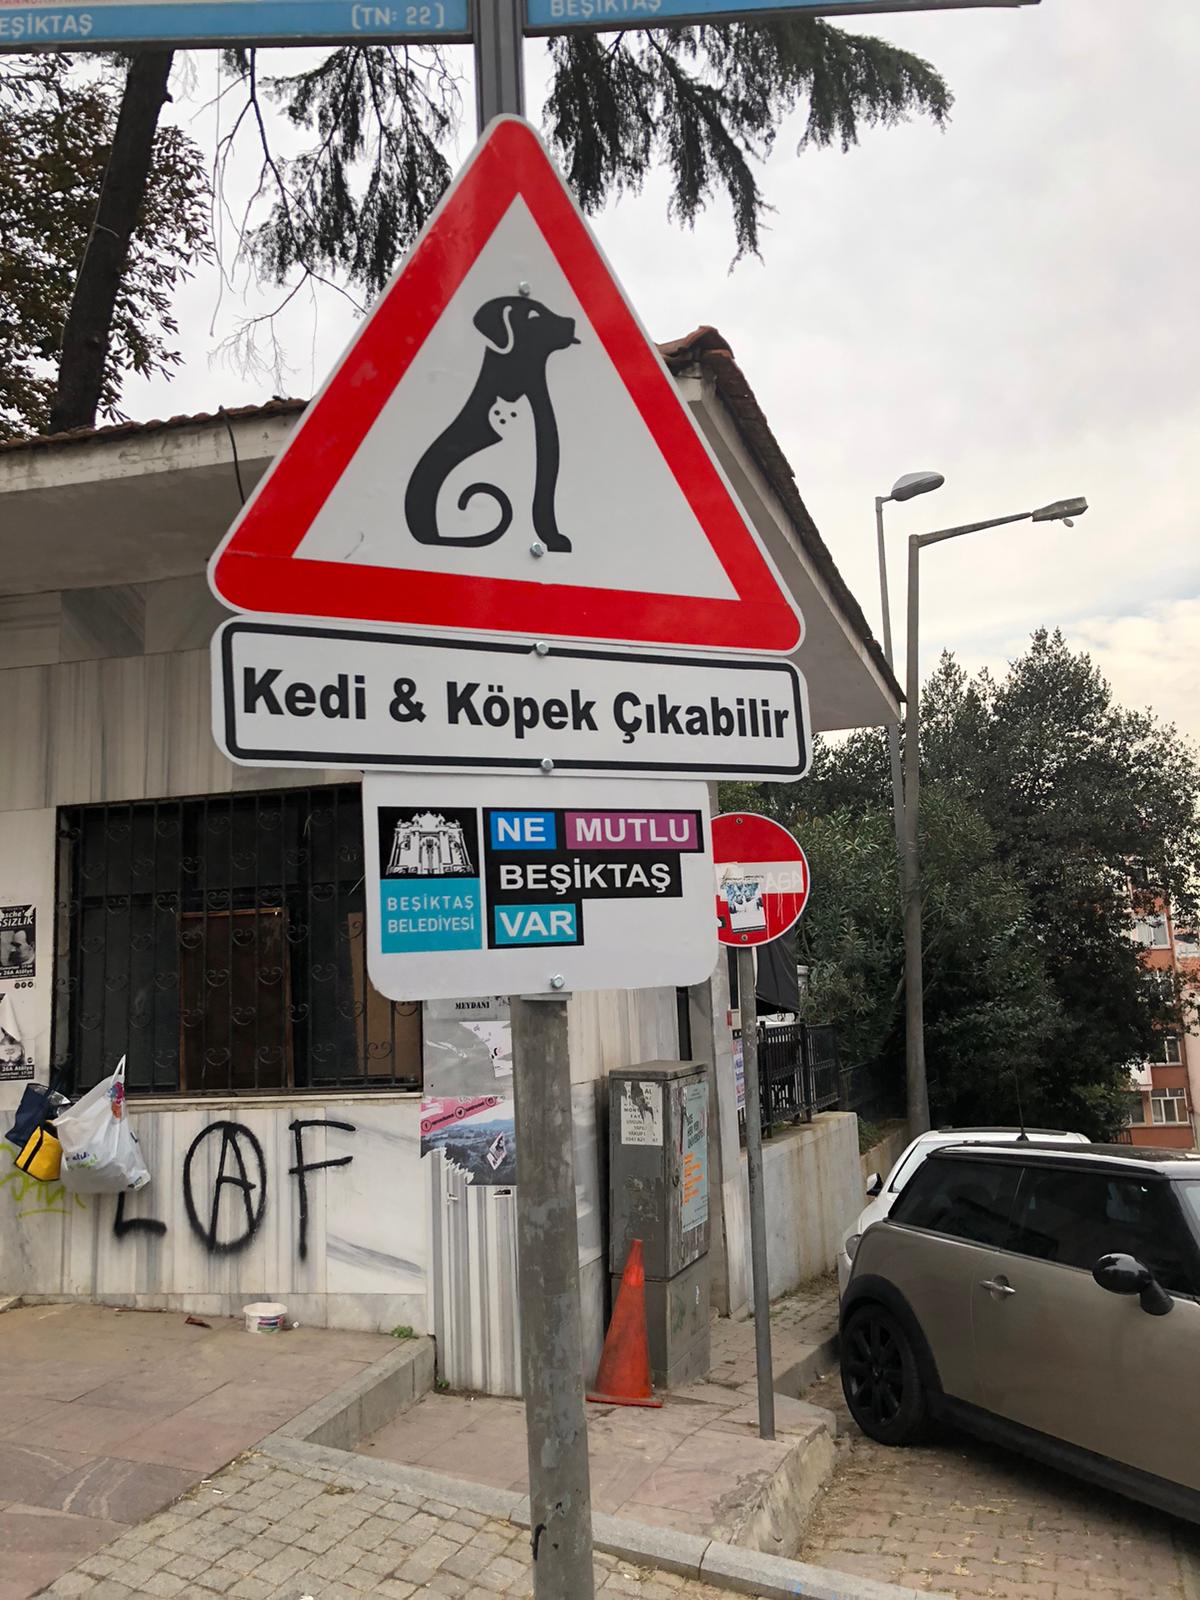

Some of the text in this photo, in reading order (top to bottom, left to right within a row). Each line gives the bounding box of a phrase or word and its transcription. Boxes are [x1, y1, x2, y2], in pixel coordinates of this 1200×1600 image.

[243, 666, 789, 744] Kedi & Köpek Çıkabilir
[497, 817, 690, 843] NE MUTLU
[500, 858, 671, 895] BEŞİKTAŞ
[387, 892, 474, 912] BEŞİKTAŞ
[387, 913, 475, 934] BELEDİYESİ
[499, 910, 574, 938] VAR
[456, 1001, 490, 1010] MEYDANI
